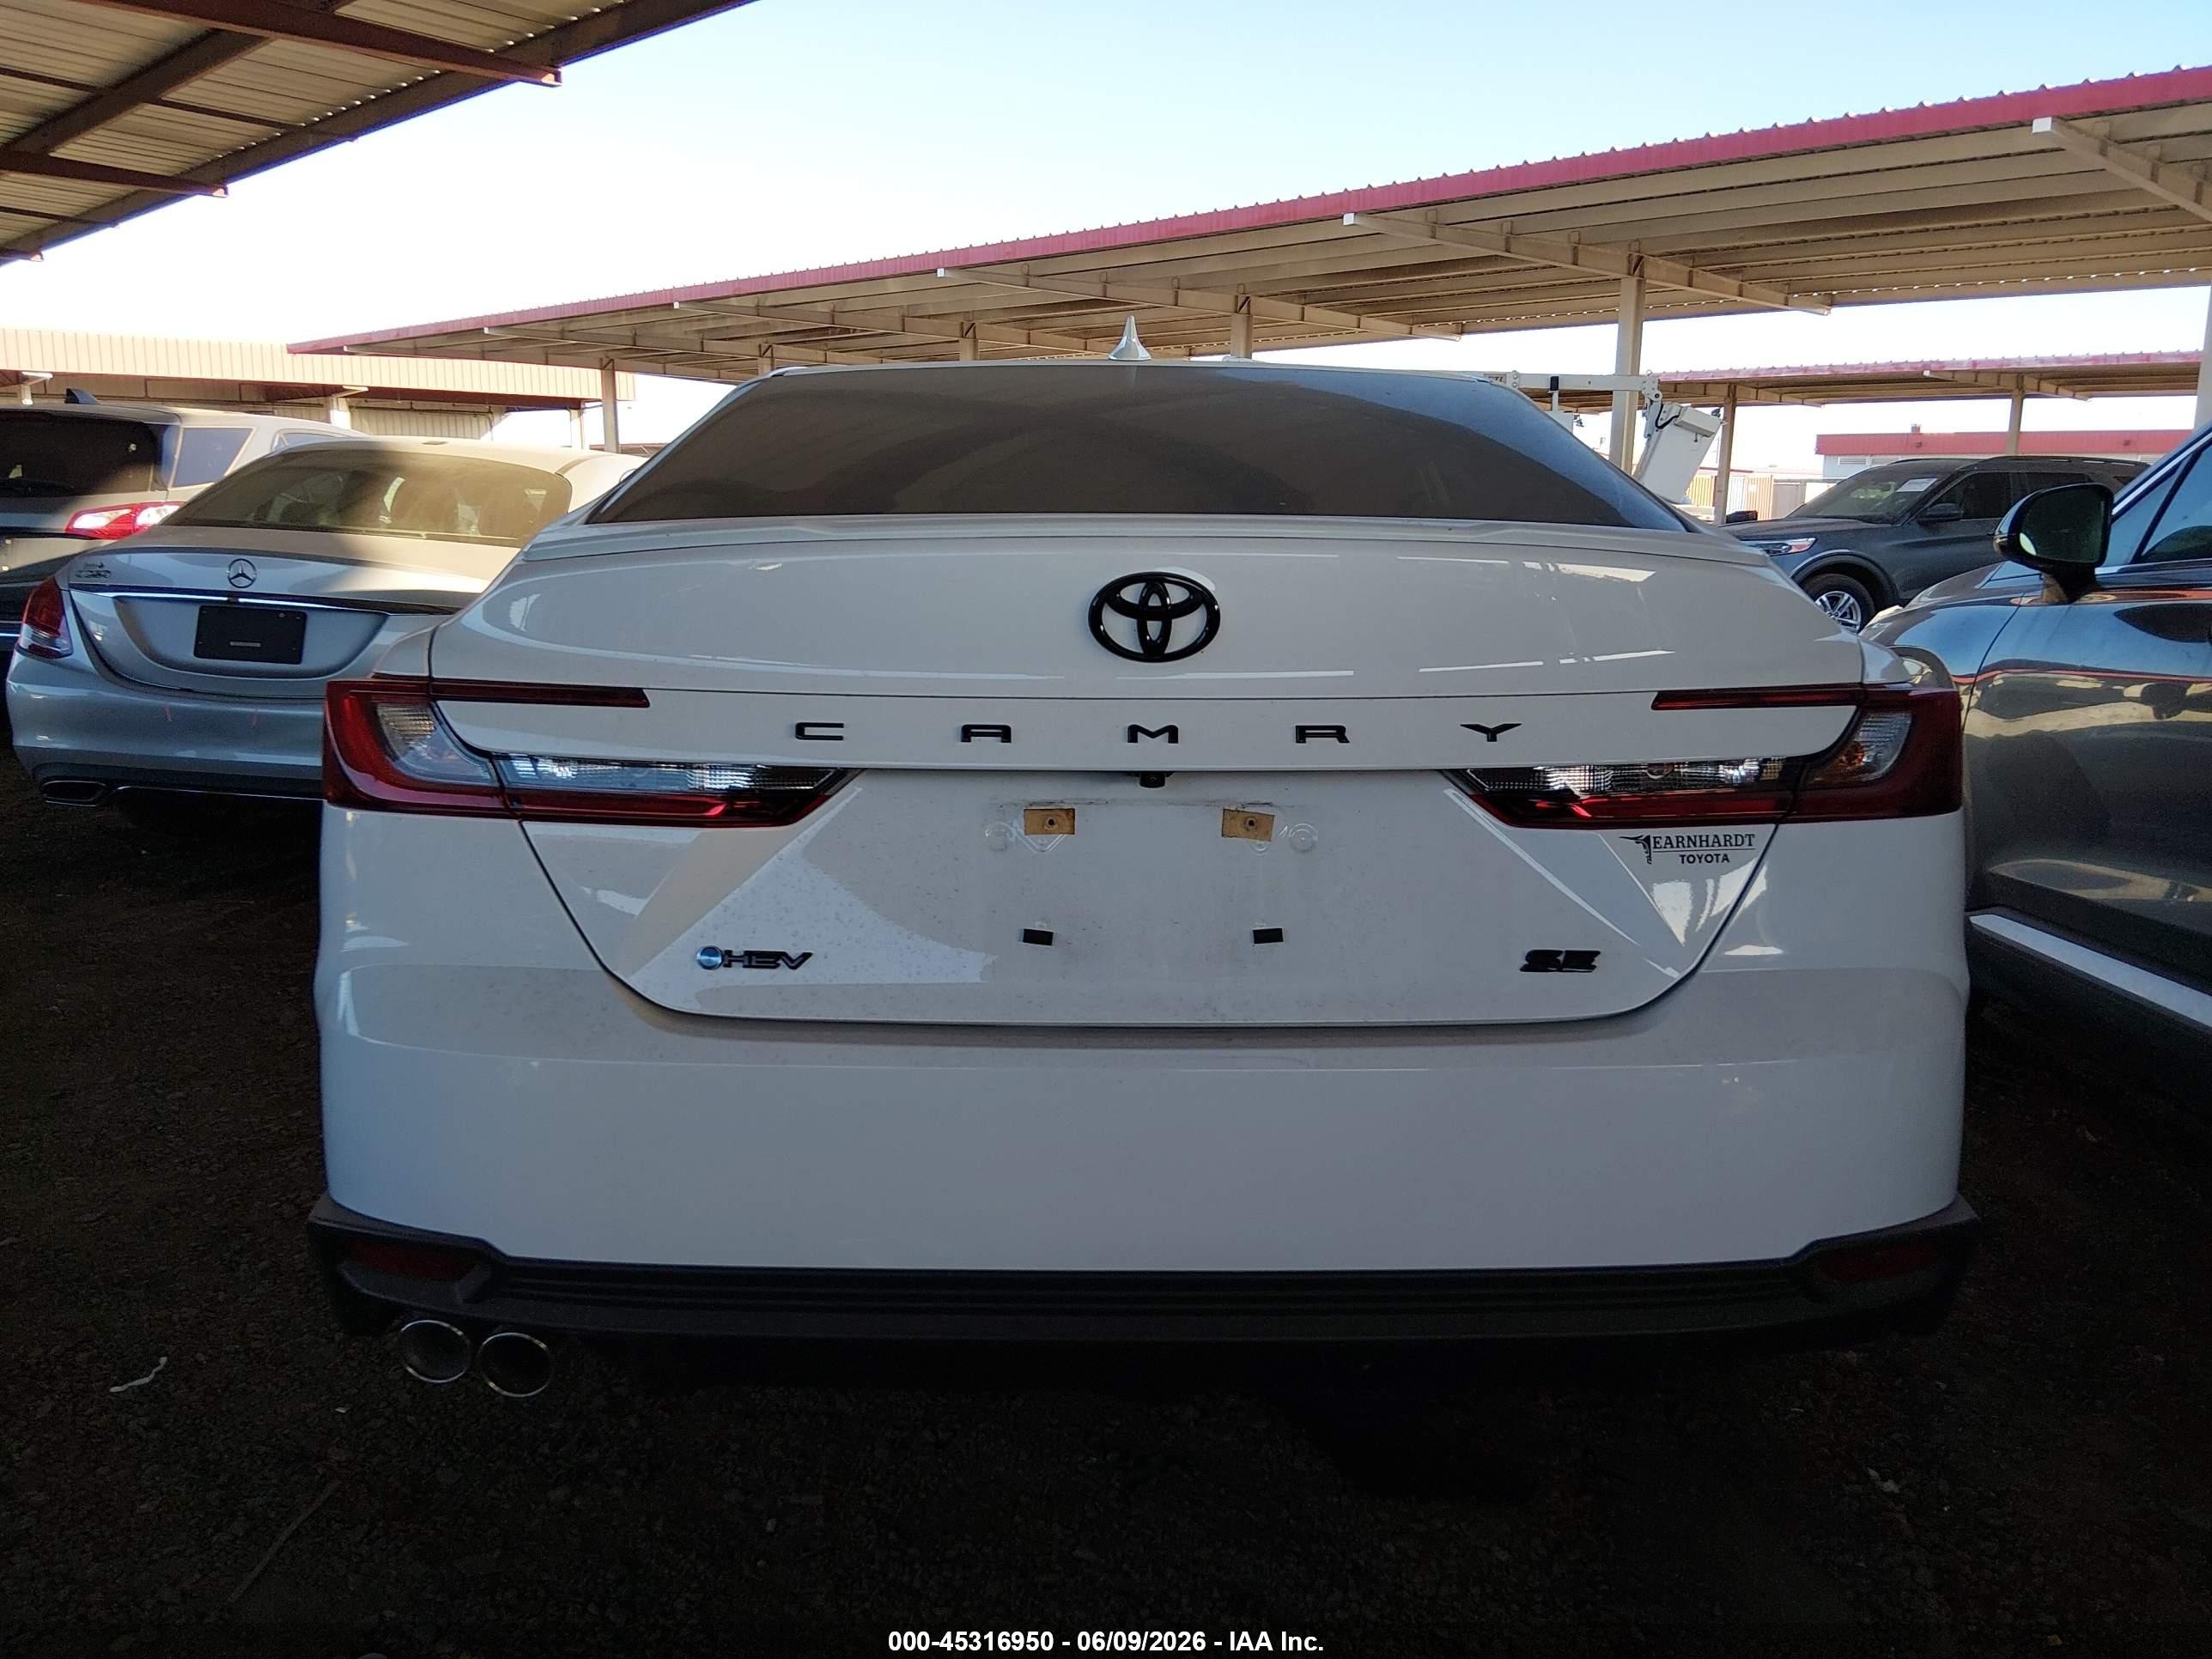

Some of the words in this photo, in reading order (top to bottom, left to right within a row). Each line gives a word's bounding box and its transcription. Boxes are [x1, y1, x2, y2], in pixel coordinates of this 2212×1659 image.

[793, 721, 1522, 744] CAMRY
[1651, 833, 1756, 850] EARNHARDT
[1679, 853, 1730, 865] TOYOTA
[722, 949, 814, 970] HEV
[1519, 949, 1601, 973] SE
